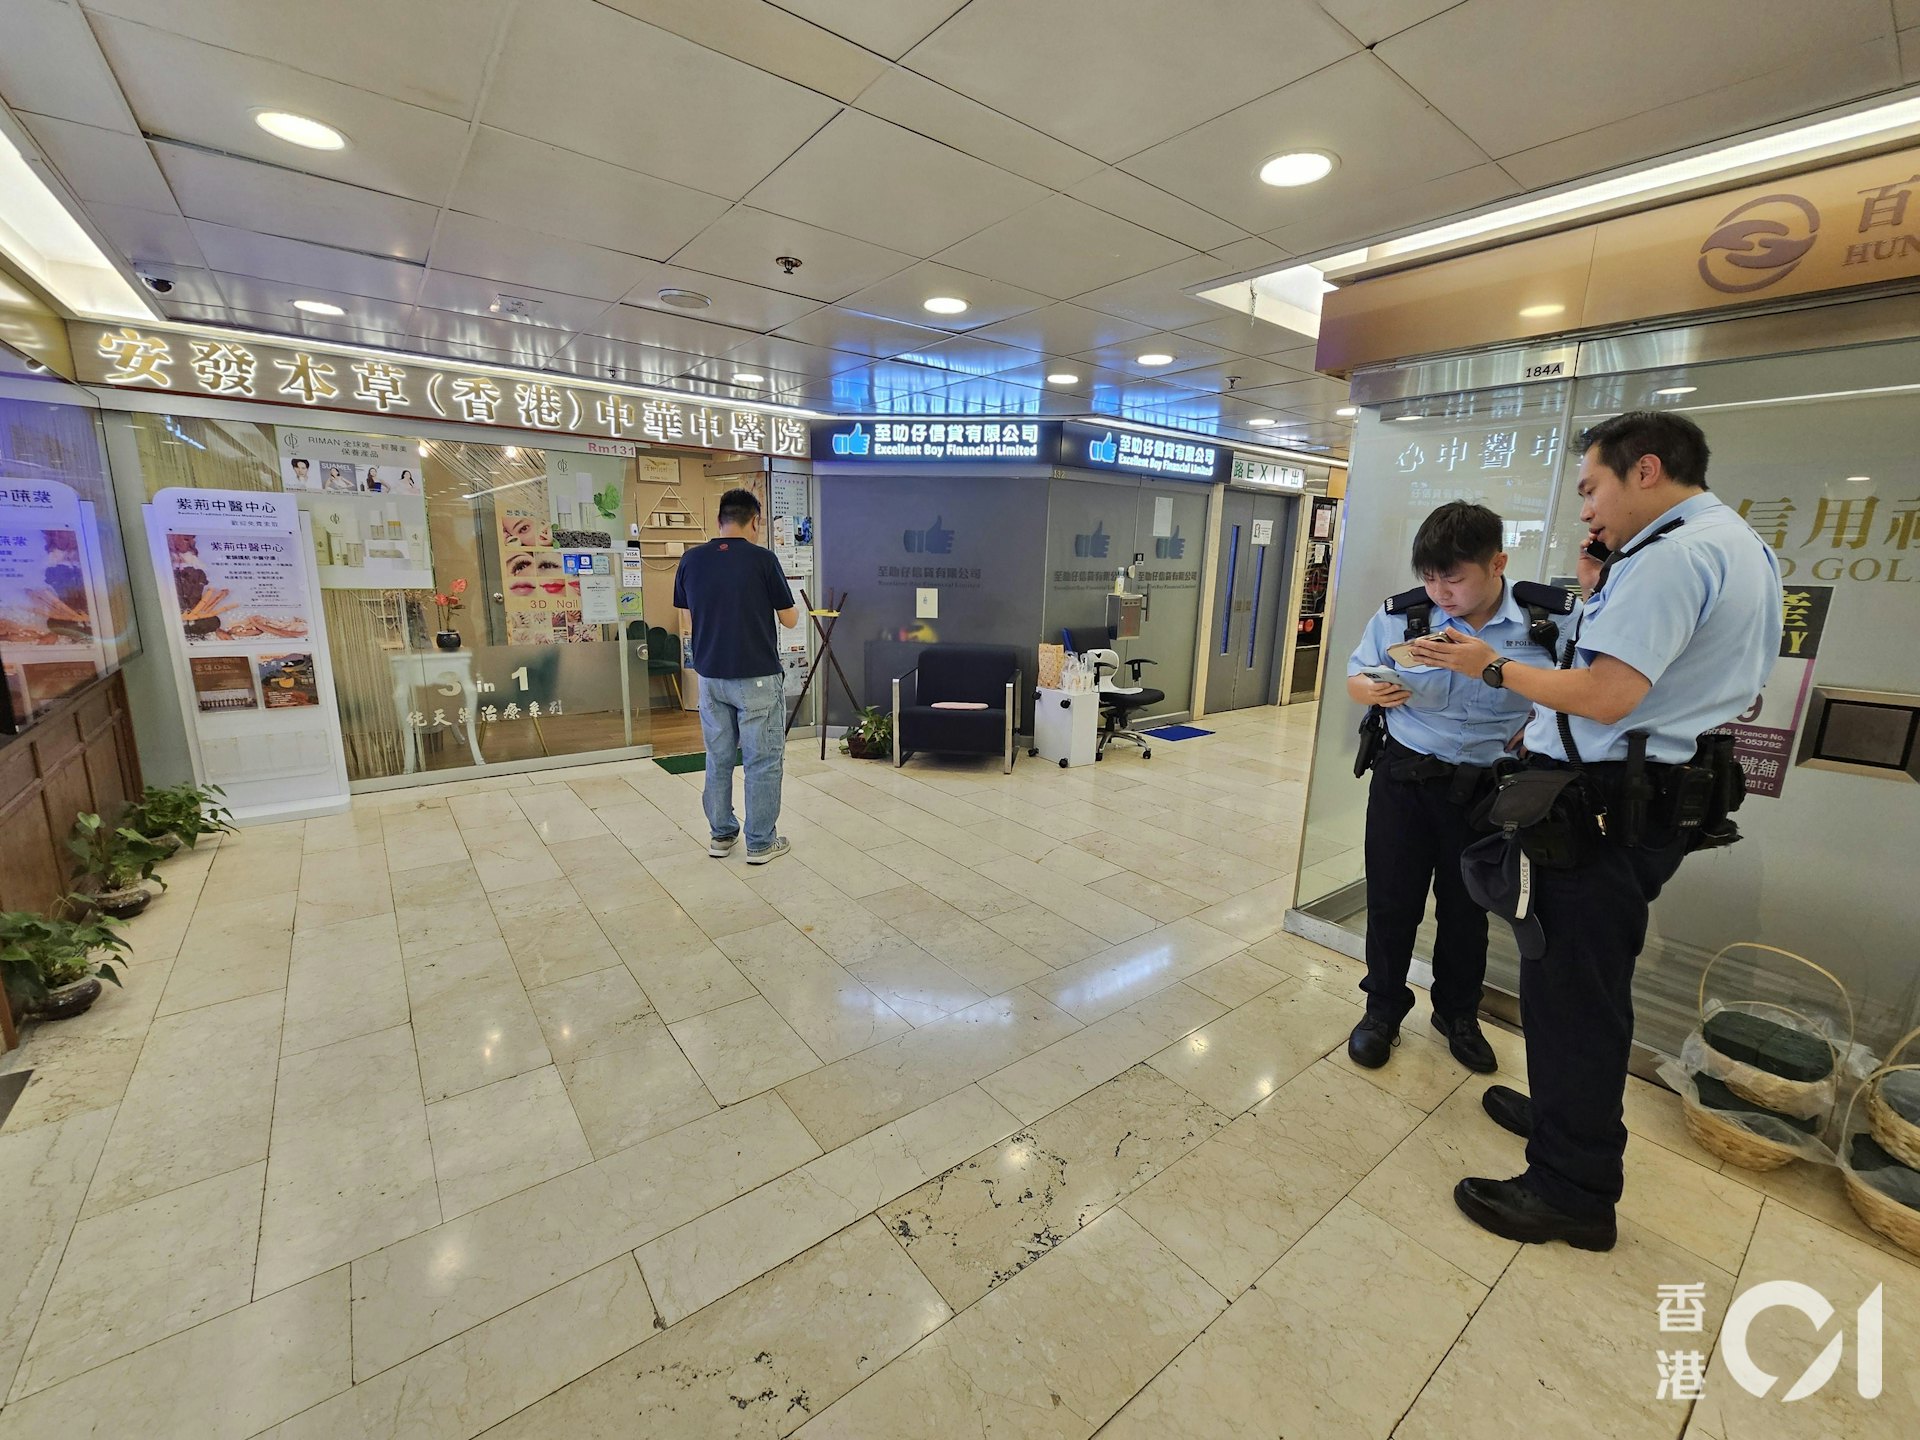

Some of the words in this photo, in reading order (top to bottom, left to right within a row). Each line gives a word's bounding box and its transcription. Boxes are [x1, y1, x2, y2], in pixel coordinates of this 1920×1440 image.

[1841, 234, 1920, 268] HUN
[1525, 364, 1562, 378] 184A
[308, 436, 341, 447] RIMAN
[588, 442, 634, 456] Rm131
[874, 444, 922, 456] Excellent
[923, 444, 944, 457] Boy
[946, 444, 994, 456] Financial
[996, 444, 1038, 457] Limited
[1118, 453, 1149, 468] Excellent
[1150, 457, 1163, 472] Boy
[1163, 459, 1191, 474] Financial
[1190, 464, 1214, 477] Limited
[1233, 460, 1244, 479] 路
[1246, 463, 1289, 483] EXIT
[1290, 470, 1300, 486] 出
[176, 498, 276, 513] 紫荊中醫中心
[211, 541, 284, 552] 紫荊中醫中心
[1053, 570, 1118, 582] 至叻仔信貸有限公
[1812, 556, 1920, 582] GOL
[530, 599, 547, 609] 3D
[556, 599, 578, 608] Nail
[477, 680, 496, 693] in
[511, 667, 529, 692] 1
[1735, 729, 1769, 739] Licence
[1769, 733, 1786, 742] No.
[1744, 778, 1774, 791] entre
